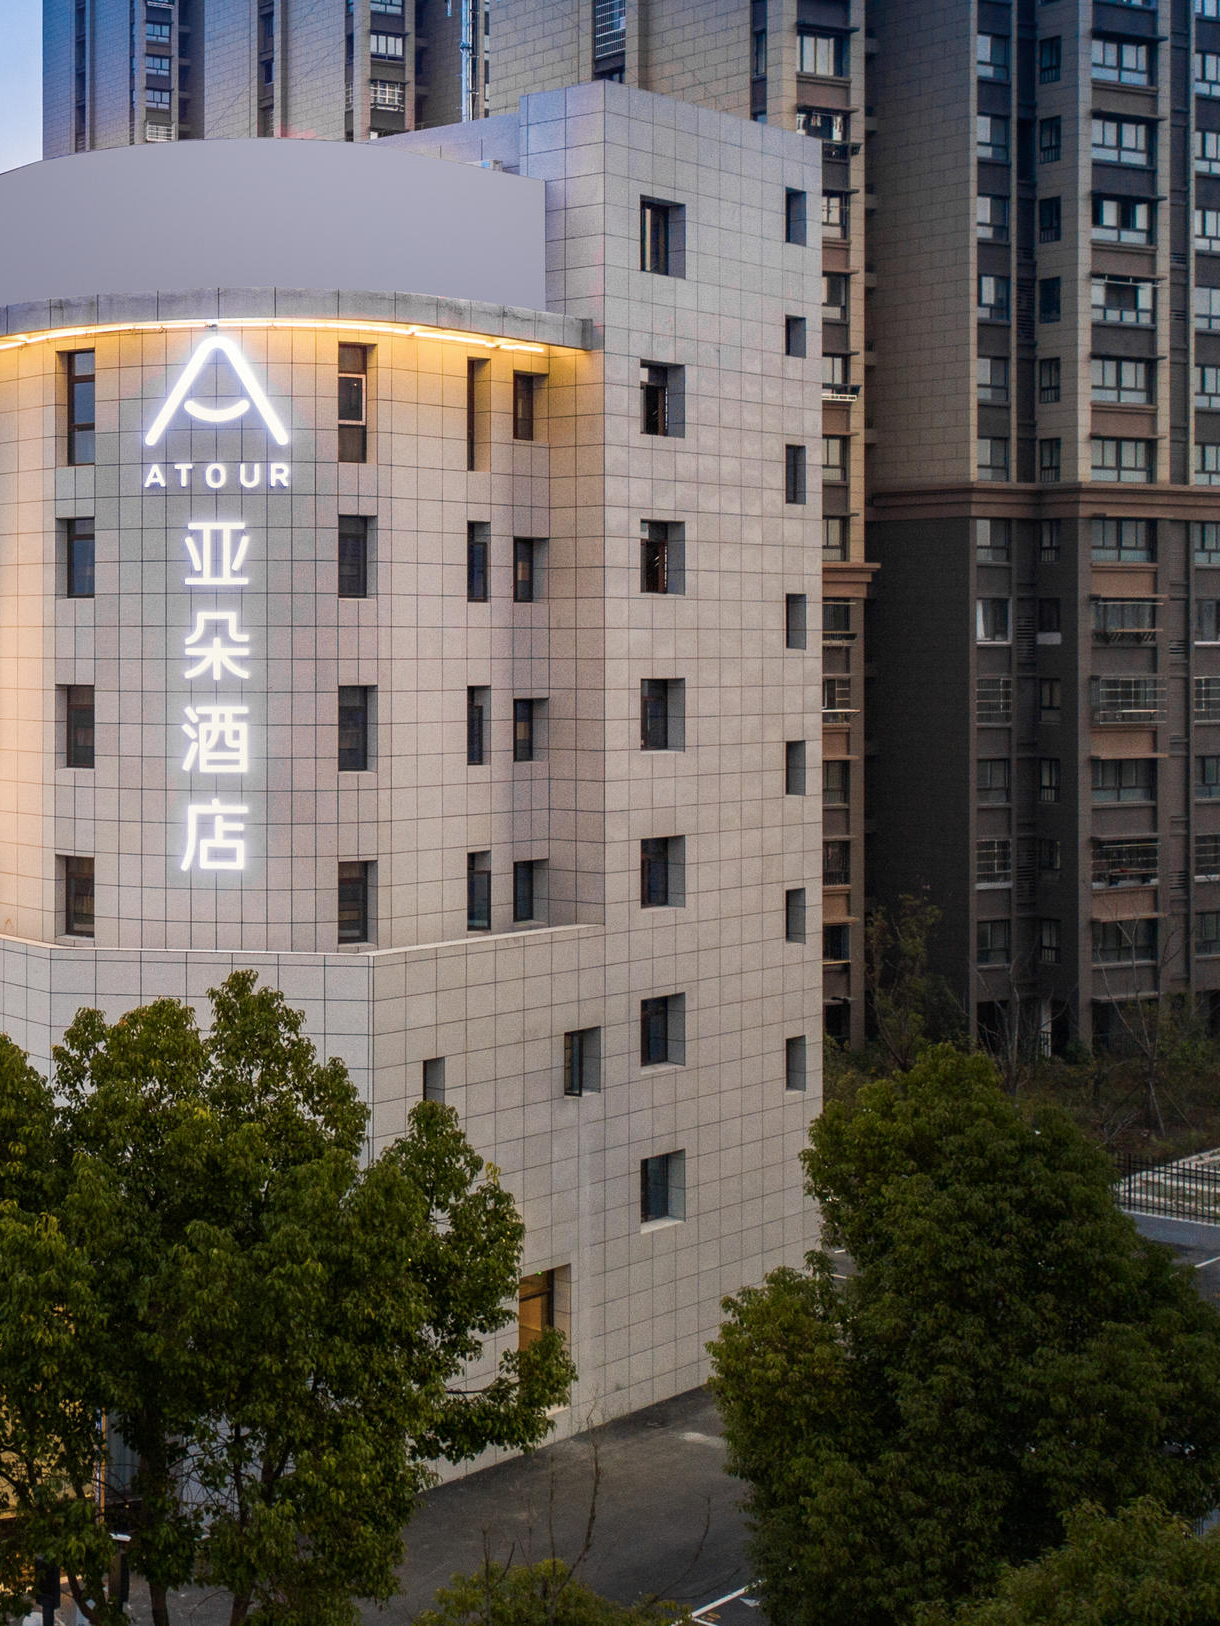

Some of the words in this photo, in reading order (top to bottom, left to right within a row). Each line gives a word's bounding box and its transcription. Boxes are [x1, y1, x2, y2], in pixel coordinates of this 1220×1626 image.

[144, 463, 289, 488] ATOUR
[182, 522, 249, 871] 亚朵酒店
